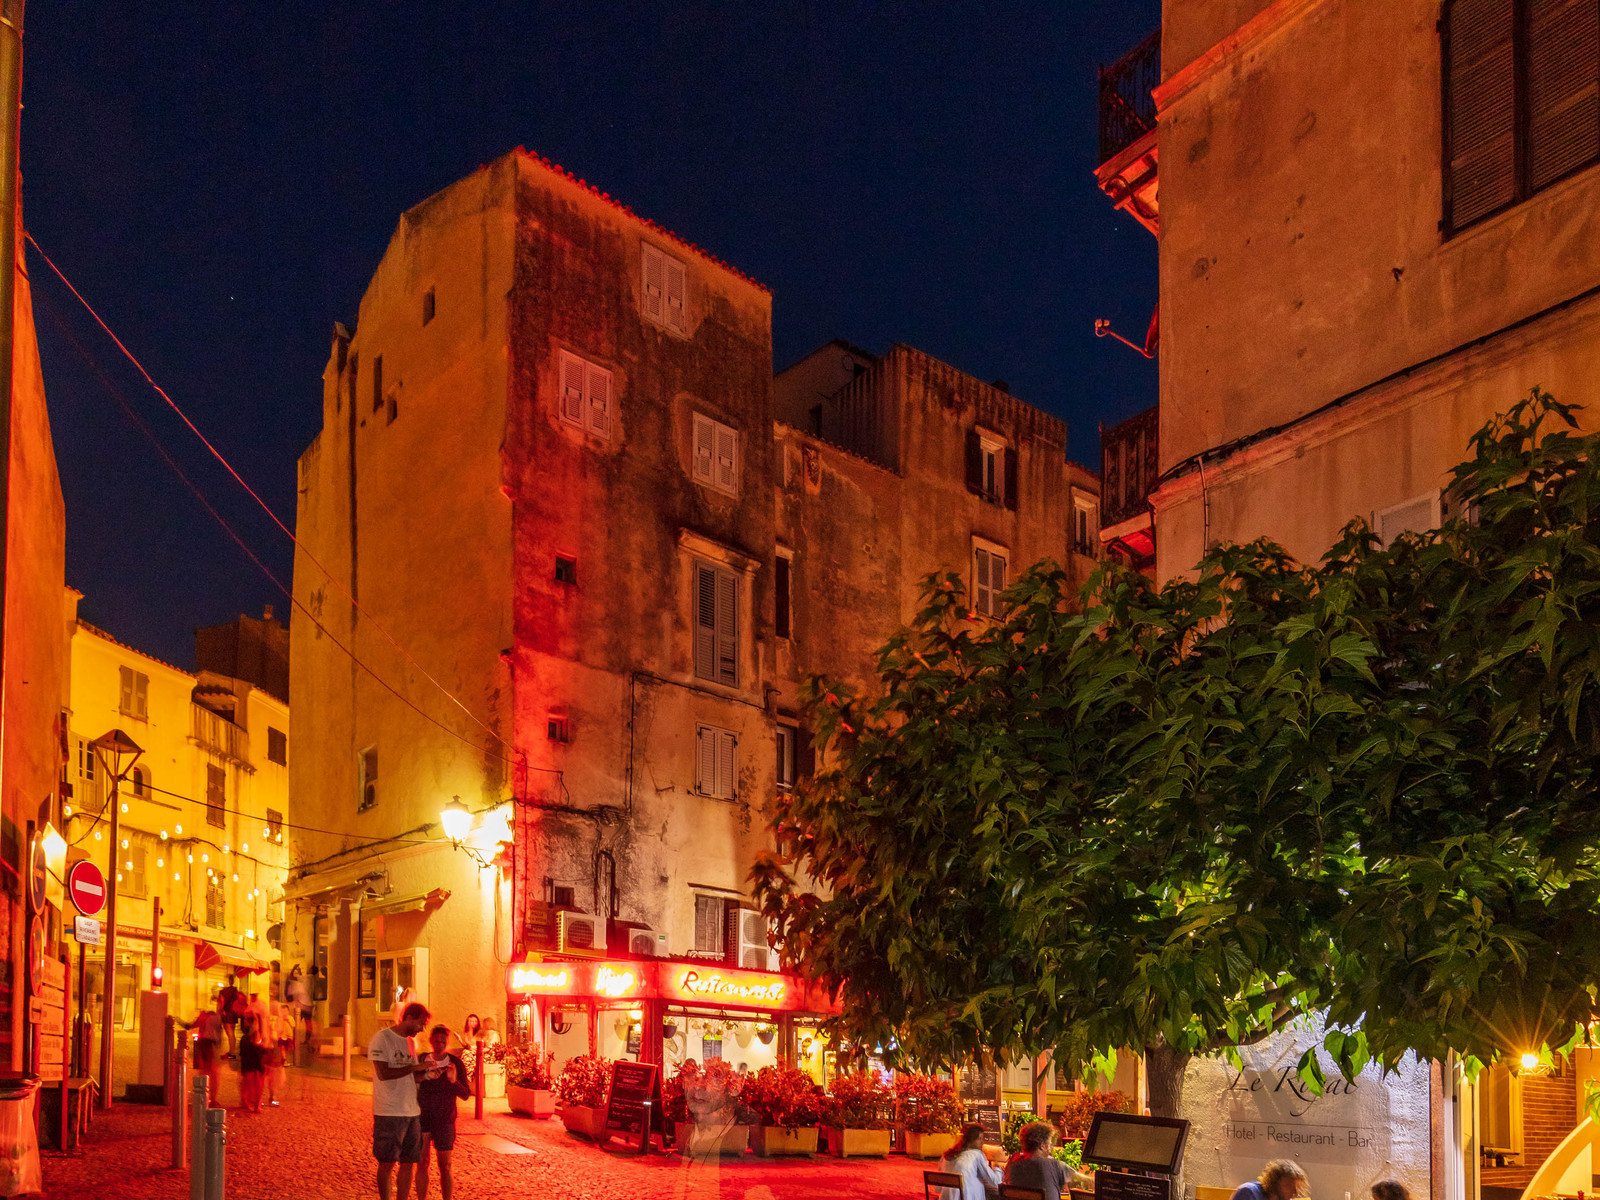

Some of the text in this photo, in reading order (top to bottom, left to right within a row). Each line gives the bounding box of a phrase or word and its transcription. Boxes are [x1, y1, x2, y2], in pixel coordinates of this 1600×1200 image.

[1227, 1065, 1264, 1092] Le
[1226, 1125, 1256, 1140] Hotel
[1267, 1125, 1336, 1146] Restaurant
[1348, 1130, 1371, 1148] Bar
